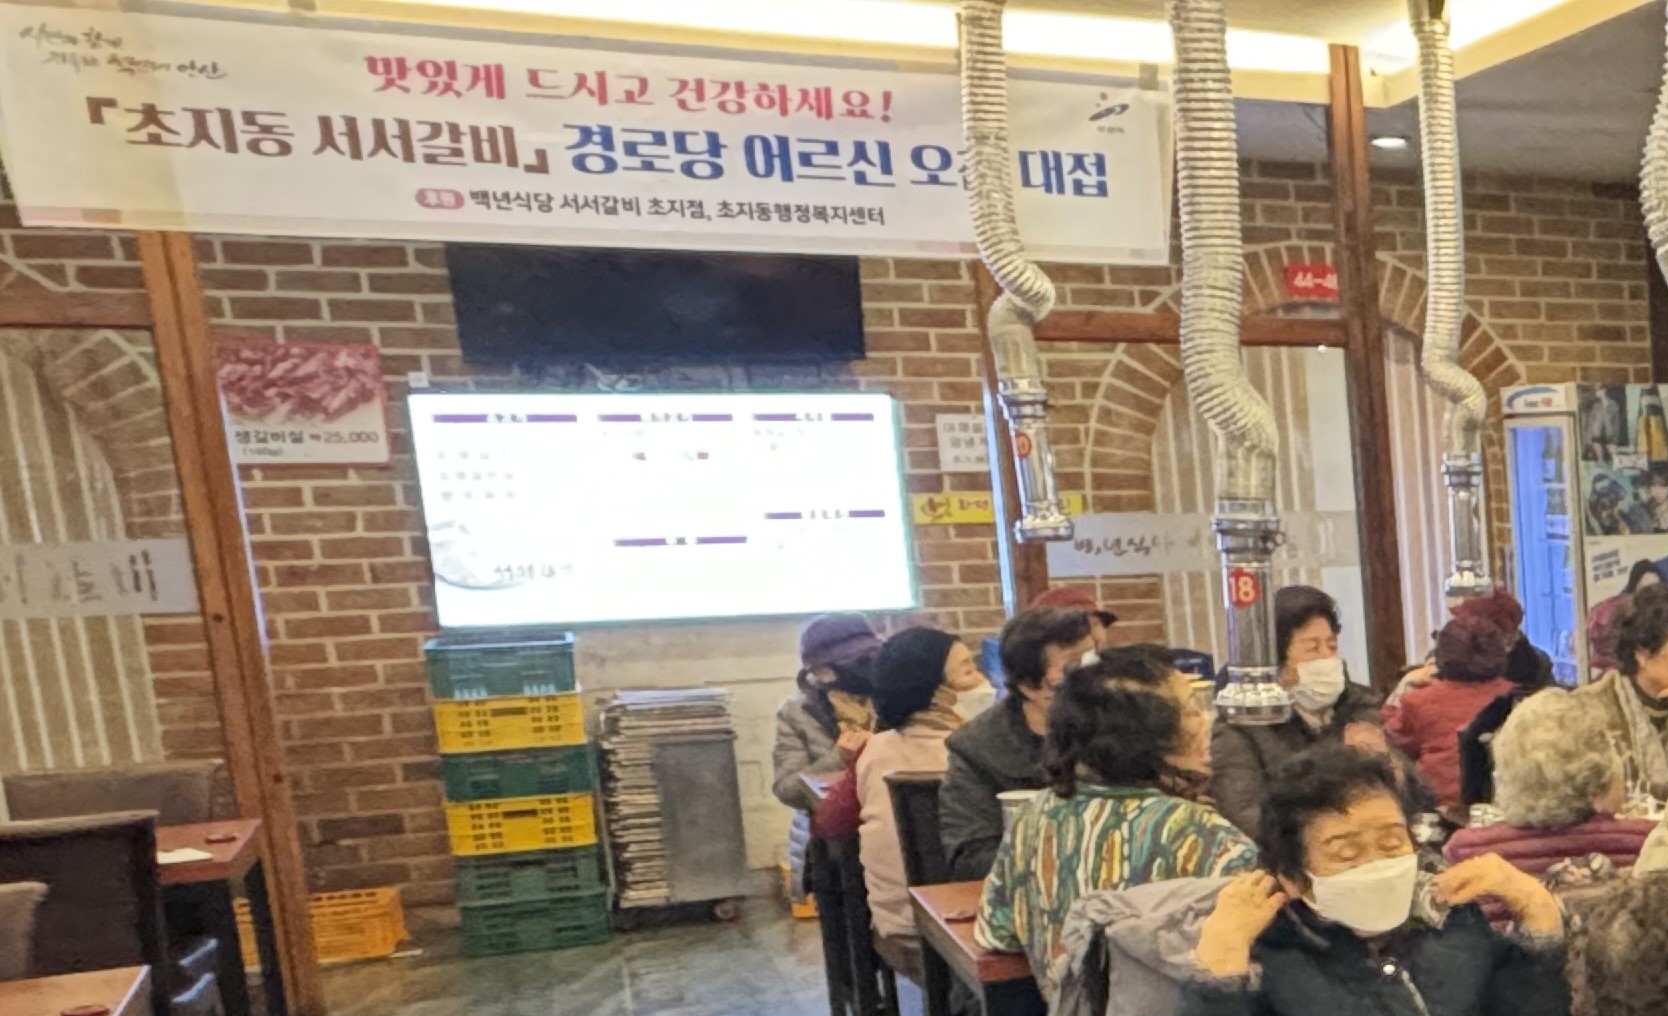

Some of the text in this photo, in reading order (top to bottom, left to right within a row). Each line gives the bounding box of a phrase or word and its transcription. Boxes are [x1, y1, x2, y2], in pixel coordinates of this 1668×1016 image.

[365, 55, 893, 123] 맛있게 드시고 건강하세요!
[562, 123, 728, 180] 경로당
[743, 133, 896, 187] 어르신
[910, 144, 970, 191] 오
[1018, 150, 1109, 197] 대접
[469, 189, 554, 213] 백년식당
[560, 193, 642, 217] 서서갈비
[717, 200, 886, 226] 초지동행정복지센터
[1228, 566, 1254, 602] 18
